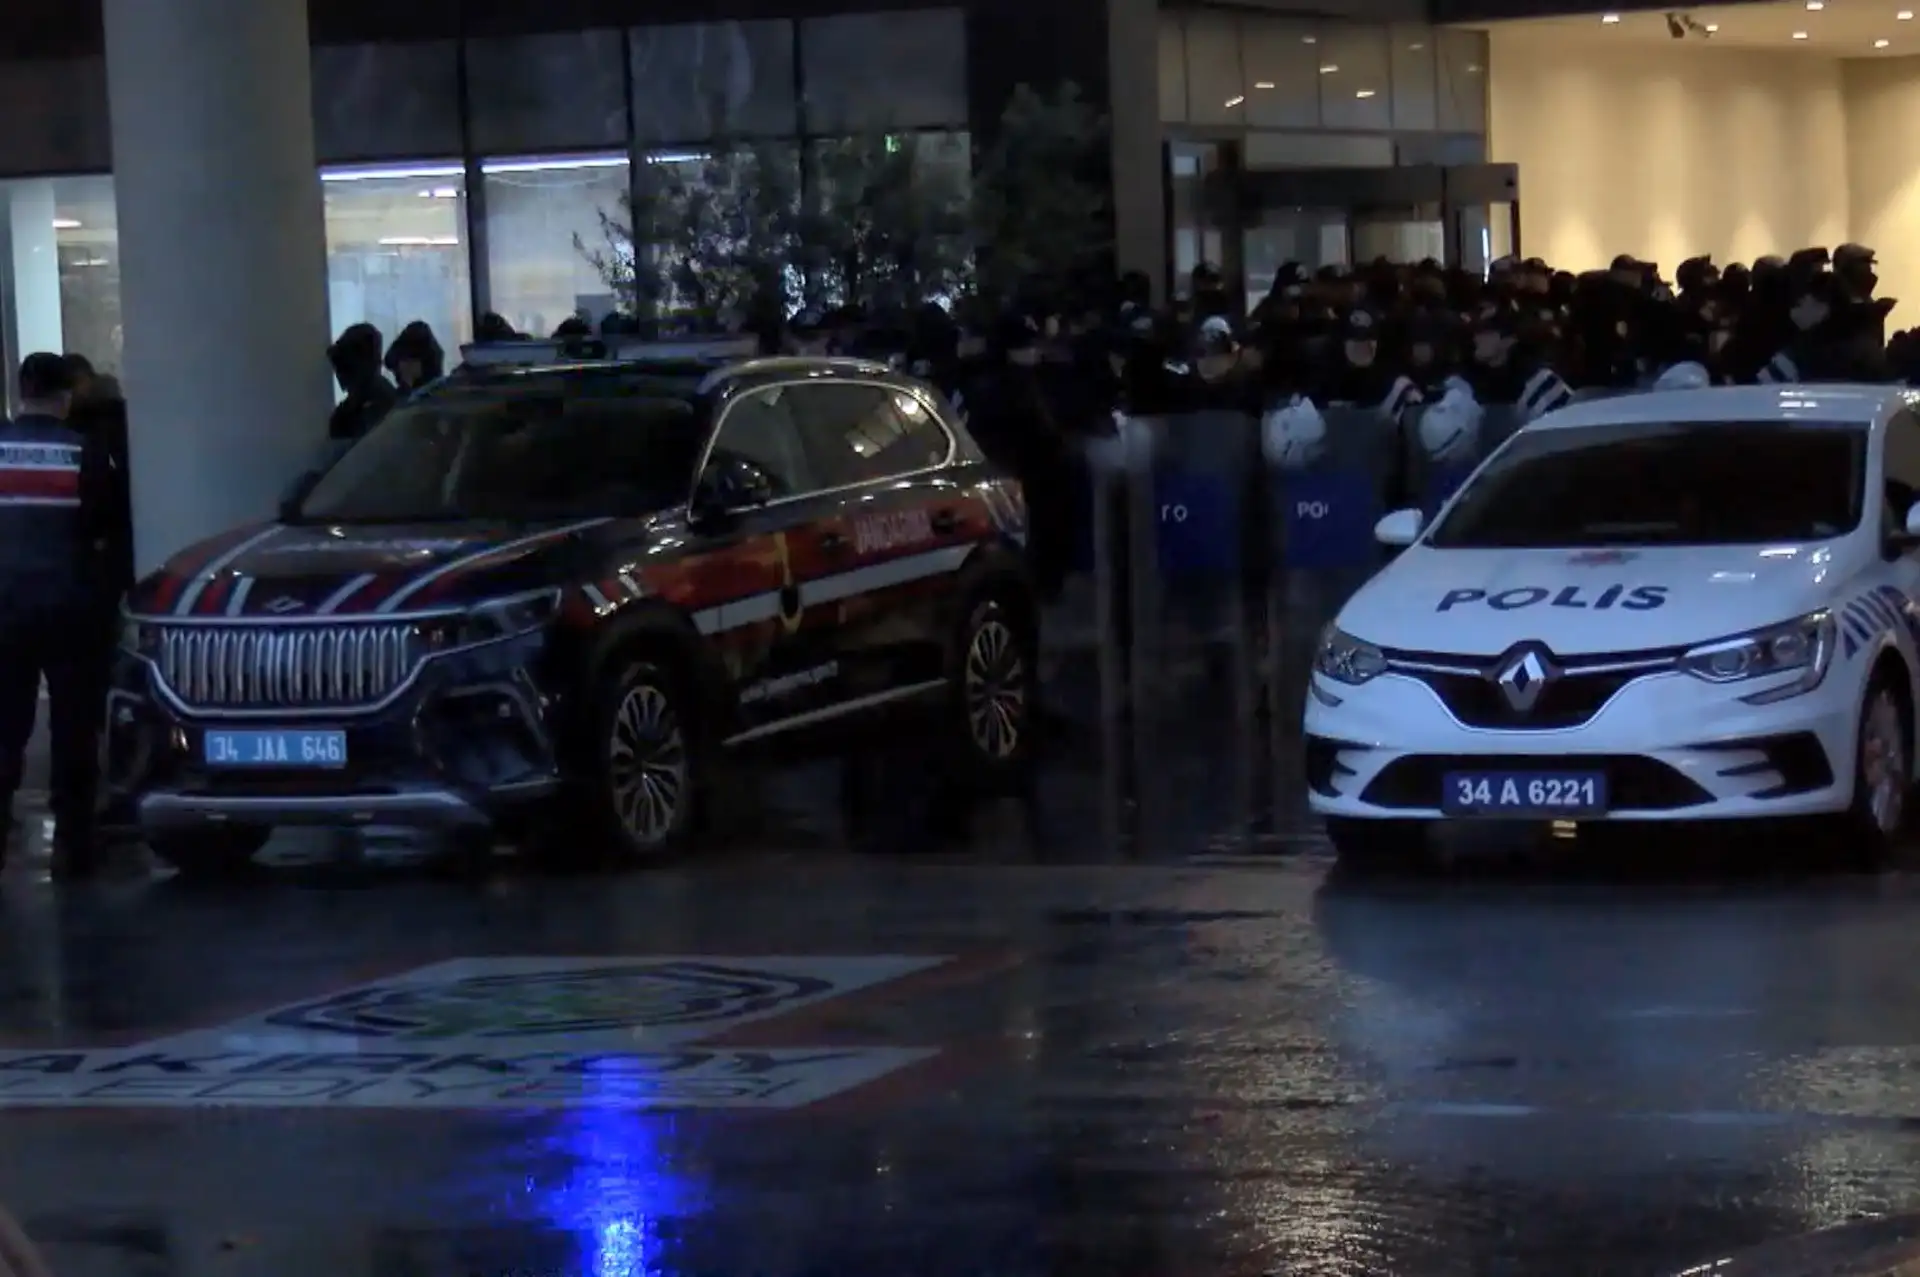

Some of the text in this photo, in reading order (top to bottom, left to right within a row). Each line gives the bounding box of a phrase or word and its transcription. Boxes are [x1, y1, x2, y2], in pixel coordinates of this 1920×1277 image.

[213, 735, 339, 761] 34 JAA 646
[1457, 777, 1595, 805] 34 A 6221
